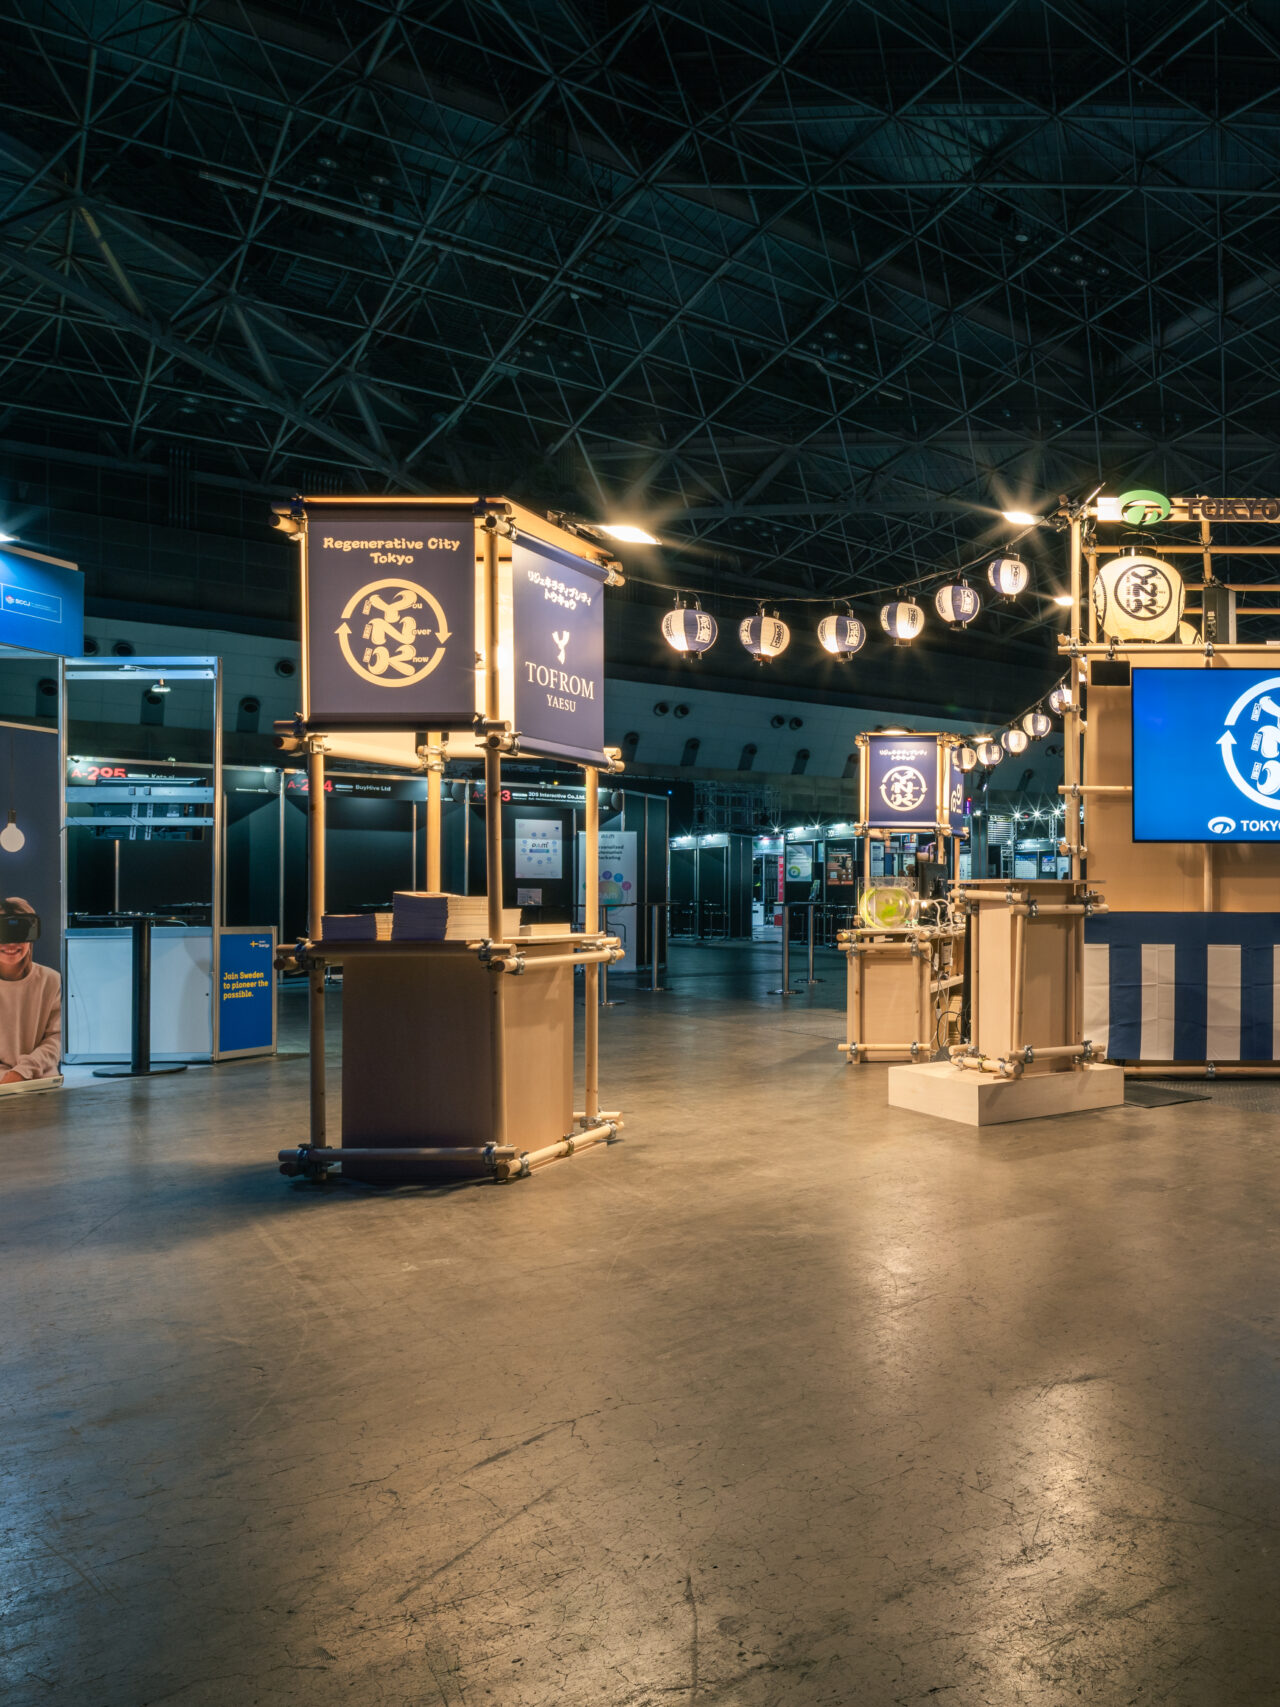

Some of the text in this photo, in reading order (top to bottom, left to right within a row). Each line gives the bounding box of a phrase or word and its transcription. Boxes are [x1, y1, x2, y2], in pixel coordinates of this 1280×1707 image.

[323, 537, 461, 552] Regenerative City
[369, 552, 414, 566] Tokyo
[525, 661, 595, 700] TOFROM
[546, 694, 577, 713] YAESU
[287, 779, 333, 793] A-24
[355, 784, 380, 792] BuyHive
[223, 970, 265, 980] Join Sweden
[223, 979, 269, 991] to pioneer the
